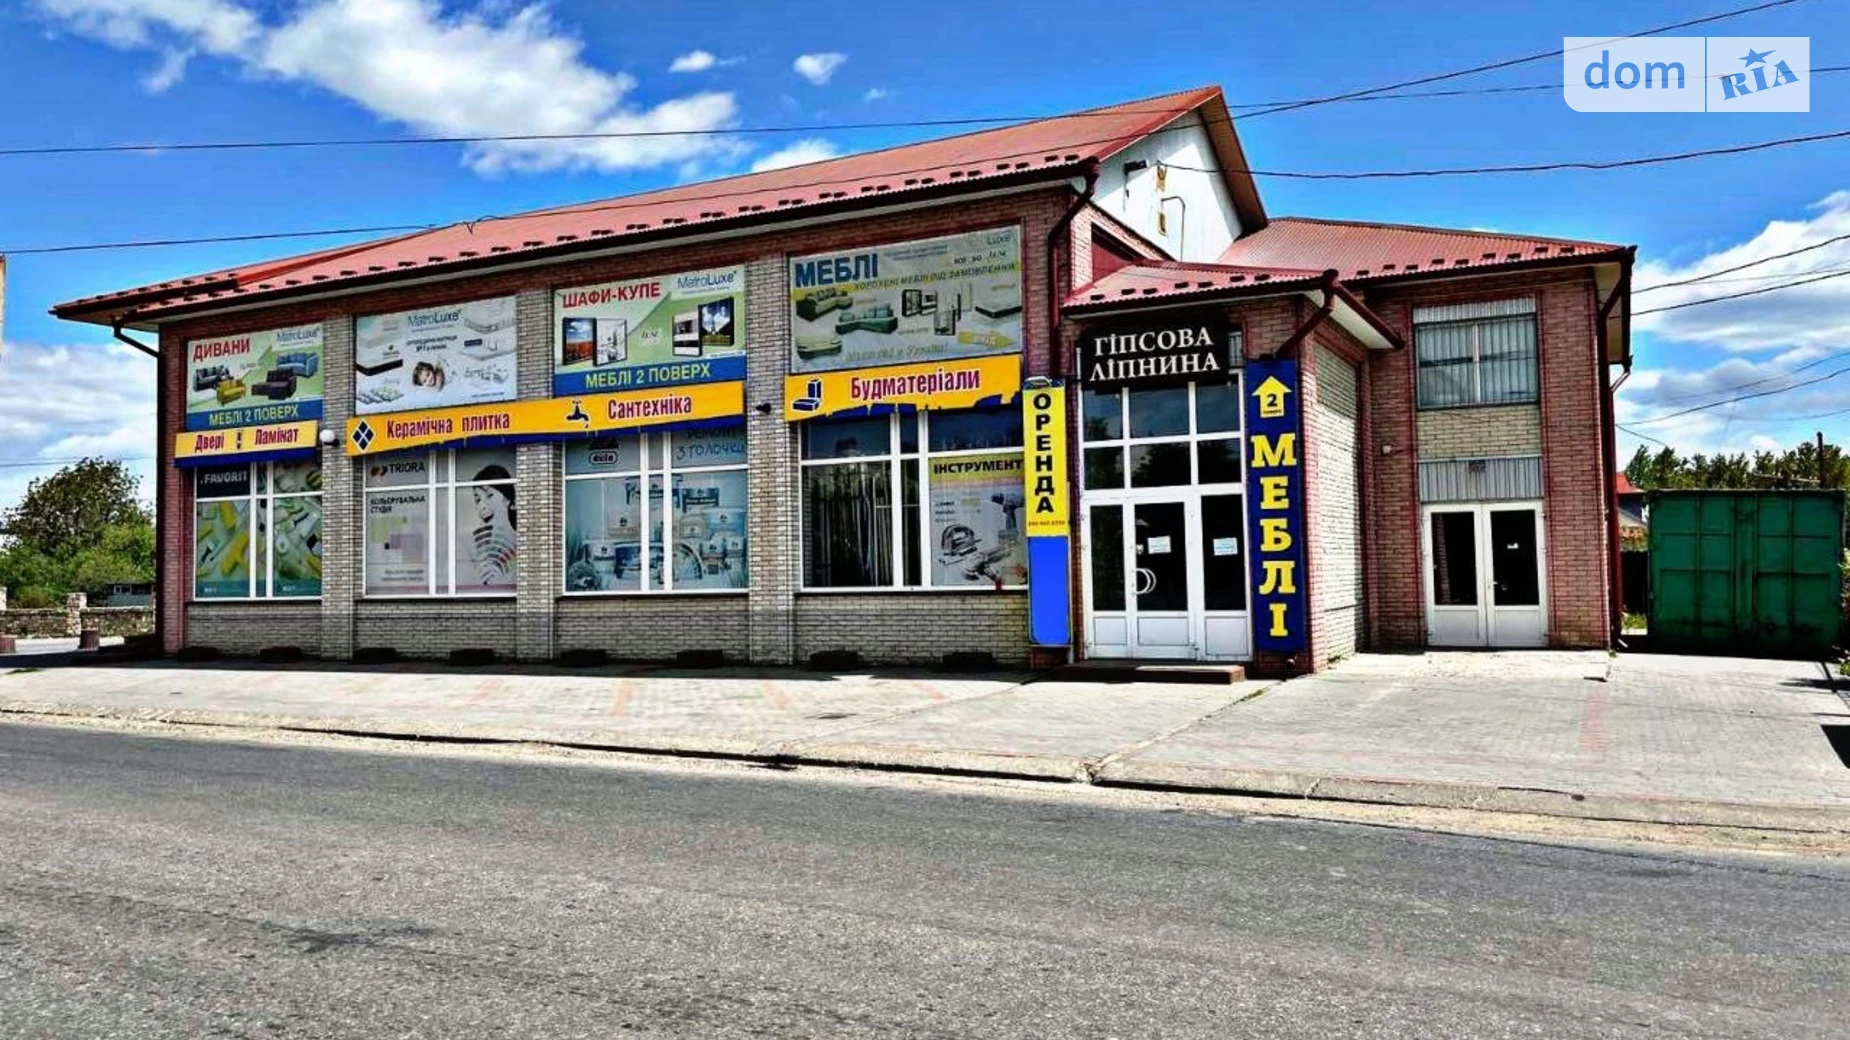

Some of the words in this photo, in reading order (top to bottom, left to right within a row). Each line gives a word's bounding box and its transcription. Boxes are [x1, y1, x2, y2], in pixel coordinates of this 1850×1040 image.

[794, 253, 879, 288] МЕБЛІ
[562, 282, 660, 308] ШАФИ-КУПЕ
[193, 338, 250, 364] ДИВАНИ
[1094, 327, 1214, 356] ГІПСОВА
[585, 371, 631, 389] МЕБЛІ
[636, 369, 645, 384] 2
[649, 362, 711, 382] ПОВЕРХ
[1089, 352, 1220, 382] ЛІПНИНА
[851, 368, 980, 399] Будматеріали
[608, 393, 692, 420] Сантехніка
[1267, 393, 1278, 407] 2
[209, 411, 243, 427] МЕБЛІ
[245, 409, 252, 423] 2
[254, 404, 299, 421] ПОВЕРХ
[387, 416, 453, 439] Керамічна
[462, 413, 510, 432] плитка
[195, 433, 224, 452] Двері
[255, 427, 299, 446] Ламінат
[1033, 393, 1055, 513] ОРЕНДА
[204, 470, 249, 484] FAVORIT
[389, 461, 425, 475] TRIORA
[934, 459, 1023, 475] ІНСТРУМЕНТ
[1251, 433, 1297, 637] МЕБЛІ
